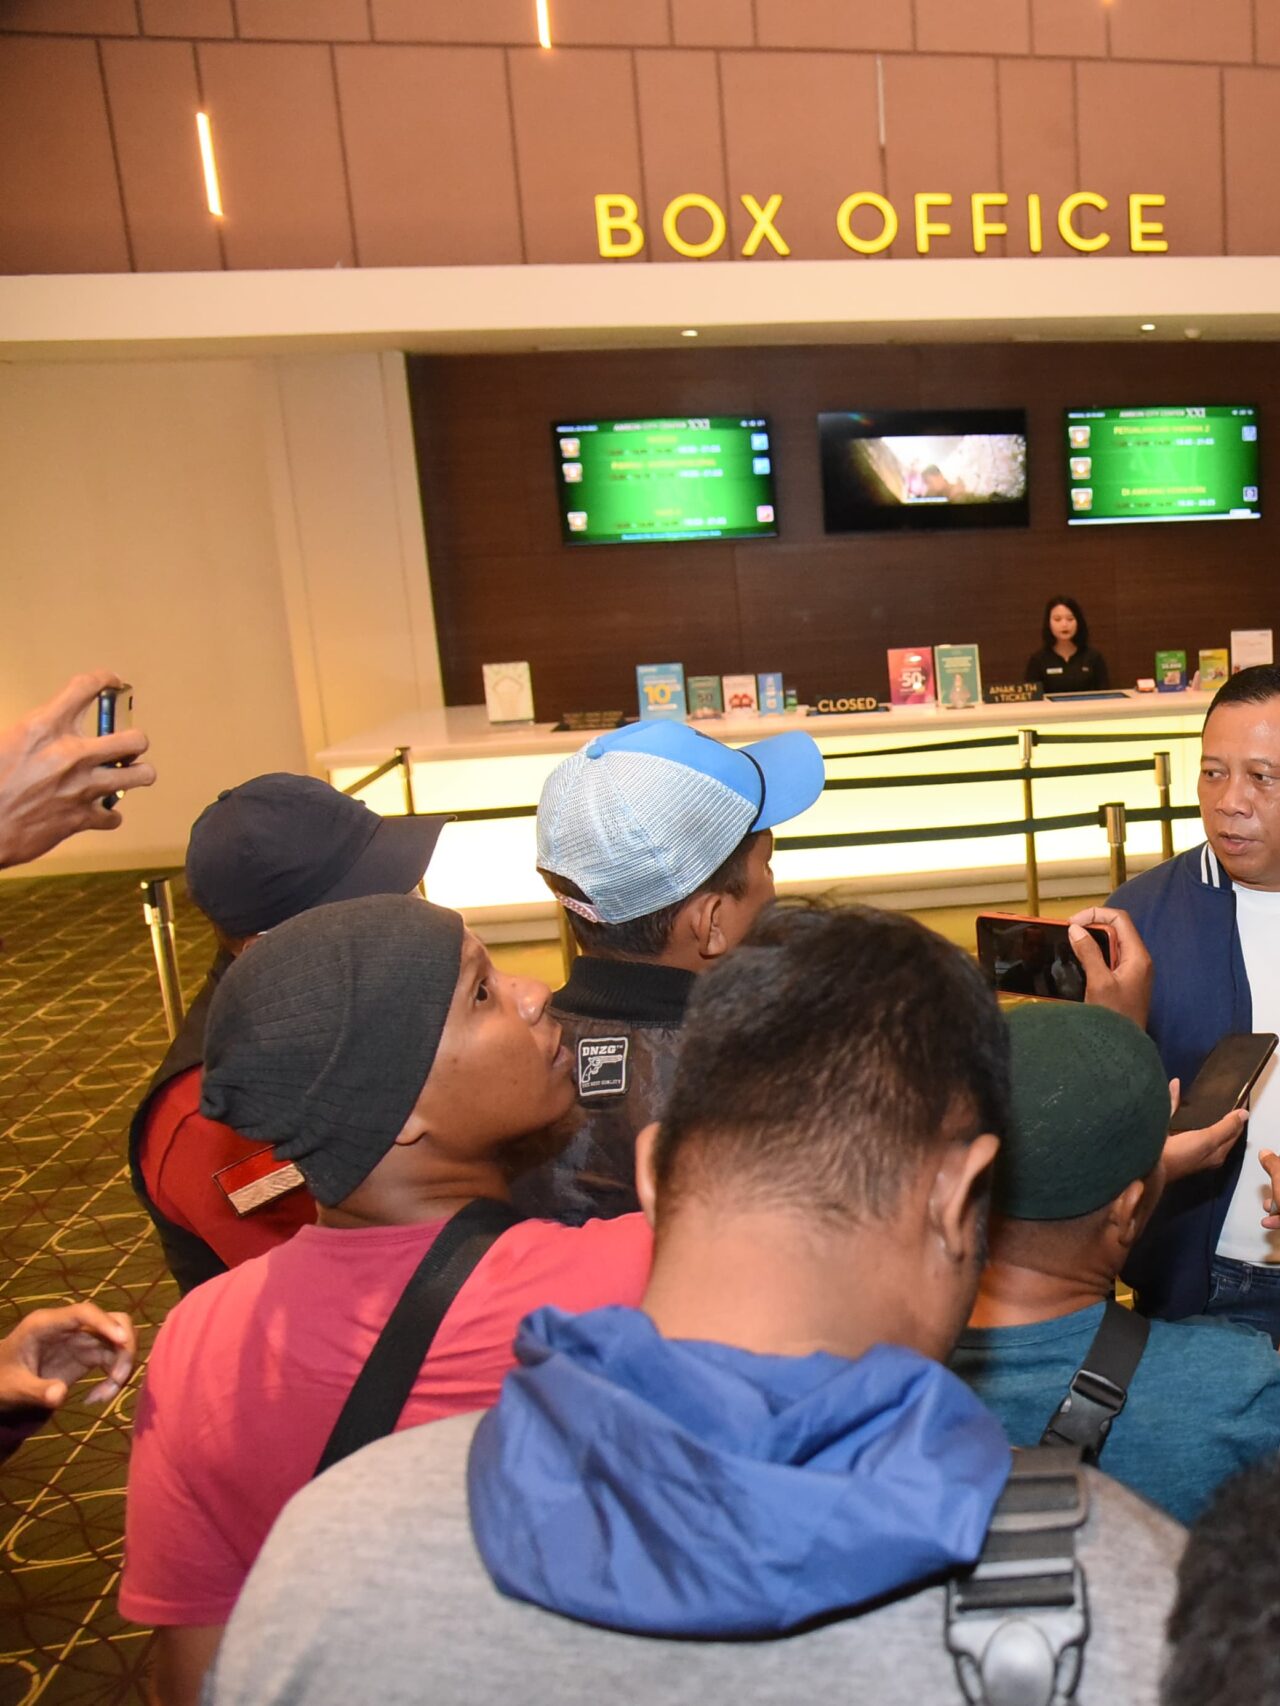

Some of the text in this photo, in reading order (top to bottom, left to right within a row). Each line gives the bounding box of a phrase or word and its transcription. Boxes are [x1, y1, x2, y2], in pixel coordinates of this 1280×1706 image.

[595, 191, 1169, 258] BOX OFFICE
[817, 697, 877, 713] CLOSED
[582, 1045, 616, 1056] DNZG
